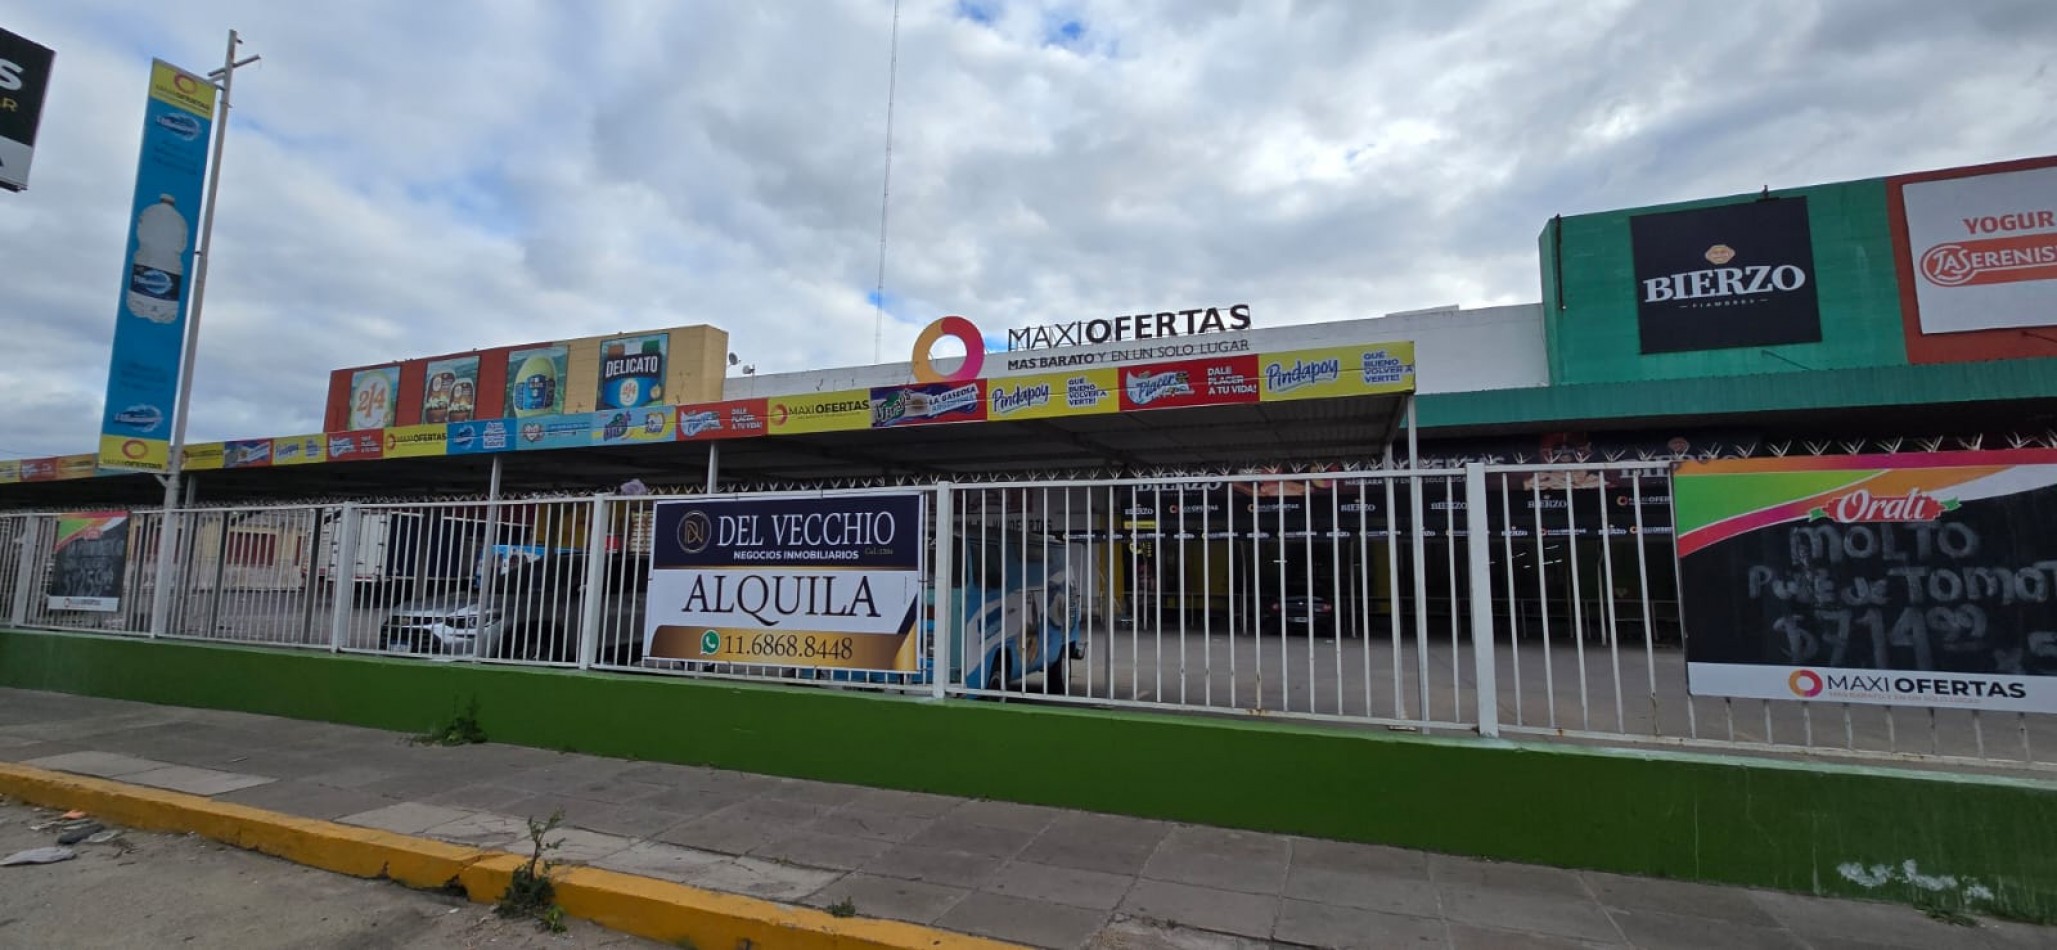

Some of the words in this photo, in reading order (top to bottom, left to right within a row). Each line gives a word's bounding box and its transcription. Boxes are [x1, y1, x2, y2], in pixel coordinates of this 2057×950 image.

[1963, 210, 2056, 235] YOGUR
[1642, 264, 1806, 303] BIERZO
[605, 355, 658, 378] DELICATO
[1008, 358, 1036, 370] MAS
[1040, 353, 1094, 368] BARATO
[1097, 352, 1106, 362] Y
[1112, 350, 1128, 361] EN
[1134, 347, 1152, 359] UN
[1158, 344, 1193, 357] SOLO
[1200, 339, 1249, 354] LUGAR
[1207, 366, 1232, 376] DALE
[1208, 375, 1244, 385] PLACER
[1266, 359, 1338, 390] Pindapoy
[1364, 367, 1403, 375] VOLVER
[992, 384, 1049, 412] Pindapoy
[1208, 387, 1216, 395] A
[1217, 386, 1230, 394] TU
[1231, 384, 1257, 393] VIDA!
[1837, 487, 1926, 524] Orali
[716, 515, 765, 546] DEL
[771, 511, 896, 546] VECCHIO
[733, 550, 782, 560] NEGOCIOS
[783, 549, 859, 560] INMOBILIARIOS
[682, 574, 881, 626] ALQUILA
[725, 634, 853, 660] 11.6868.8448
